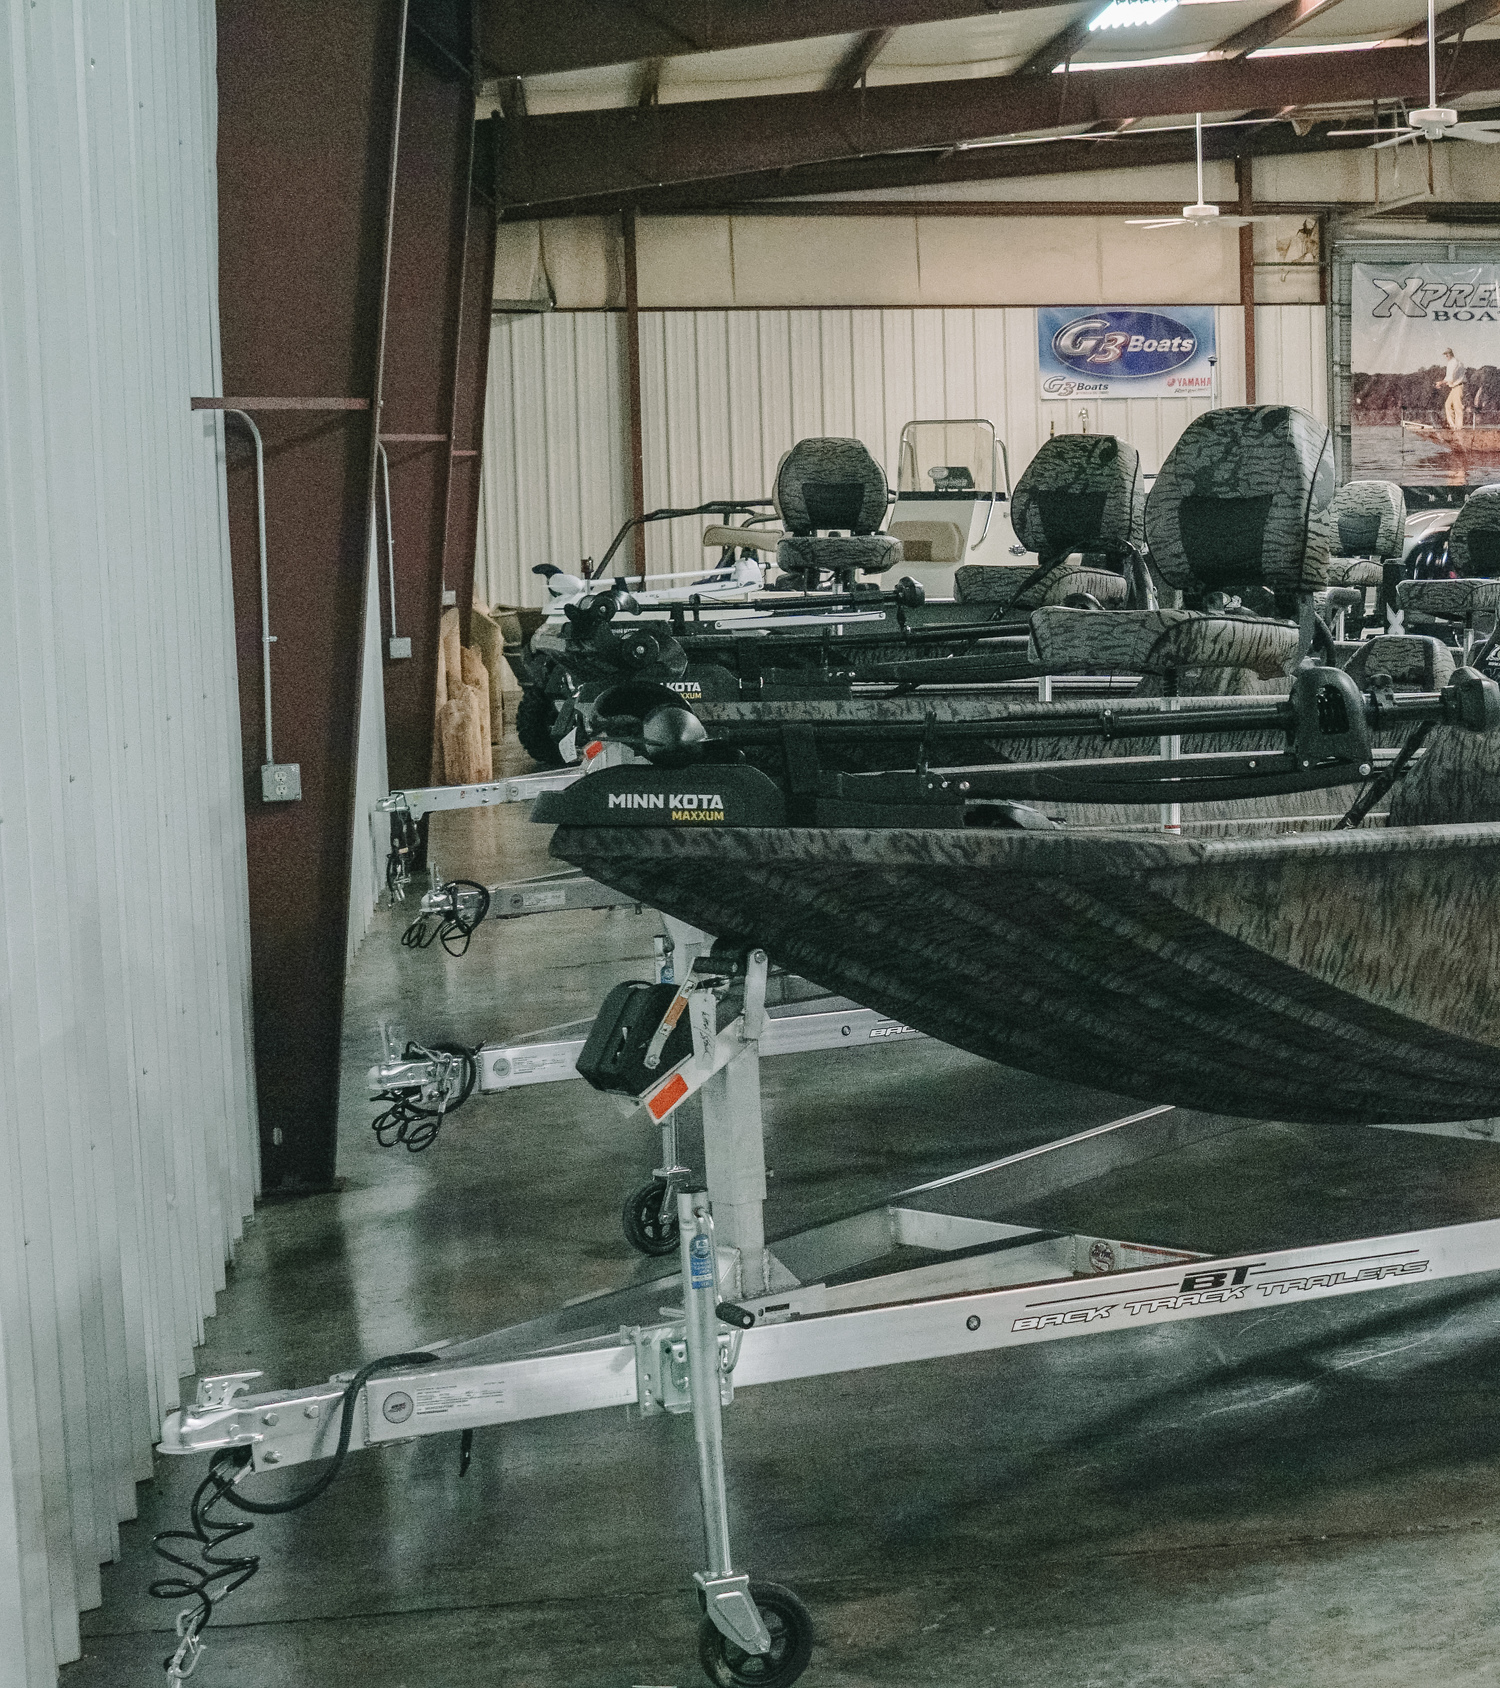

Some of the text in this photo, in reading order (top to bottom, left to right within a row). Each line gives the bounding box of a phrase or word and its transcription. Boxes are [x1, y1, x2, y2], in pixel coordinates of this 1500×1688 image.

[1057, 319, 1194, 363] G3 Boats
[1043, 375, 1109, 396] G3 Boats
[1177, 377, 1212, 387] YAMAHA
[665, 682, 701, 692] KOTA
[608, 793, 724, 809] MINN KOTA
[672, 810, 725, 821] MAXXUM
[1180, 1263, 1266, 1294] BT
[1011, 1259, 1430, 1333] BACK TRACK TRAILERS
